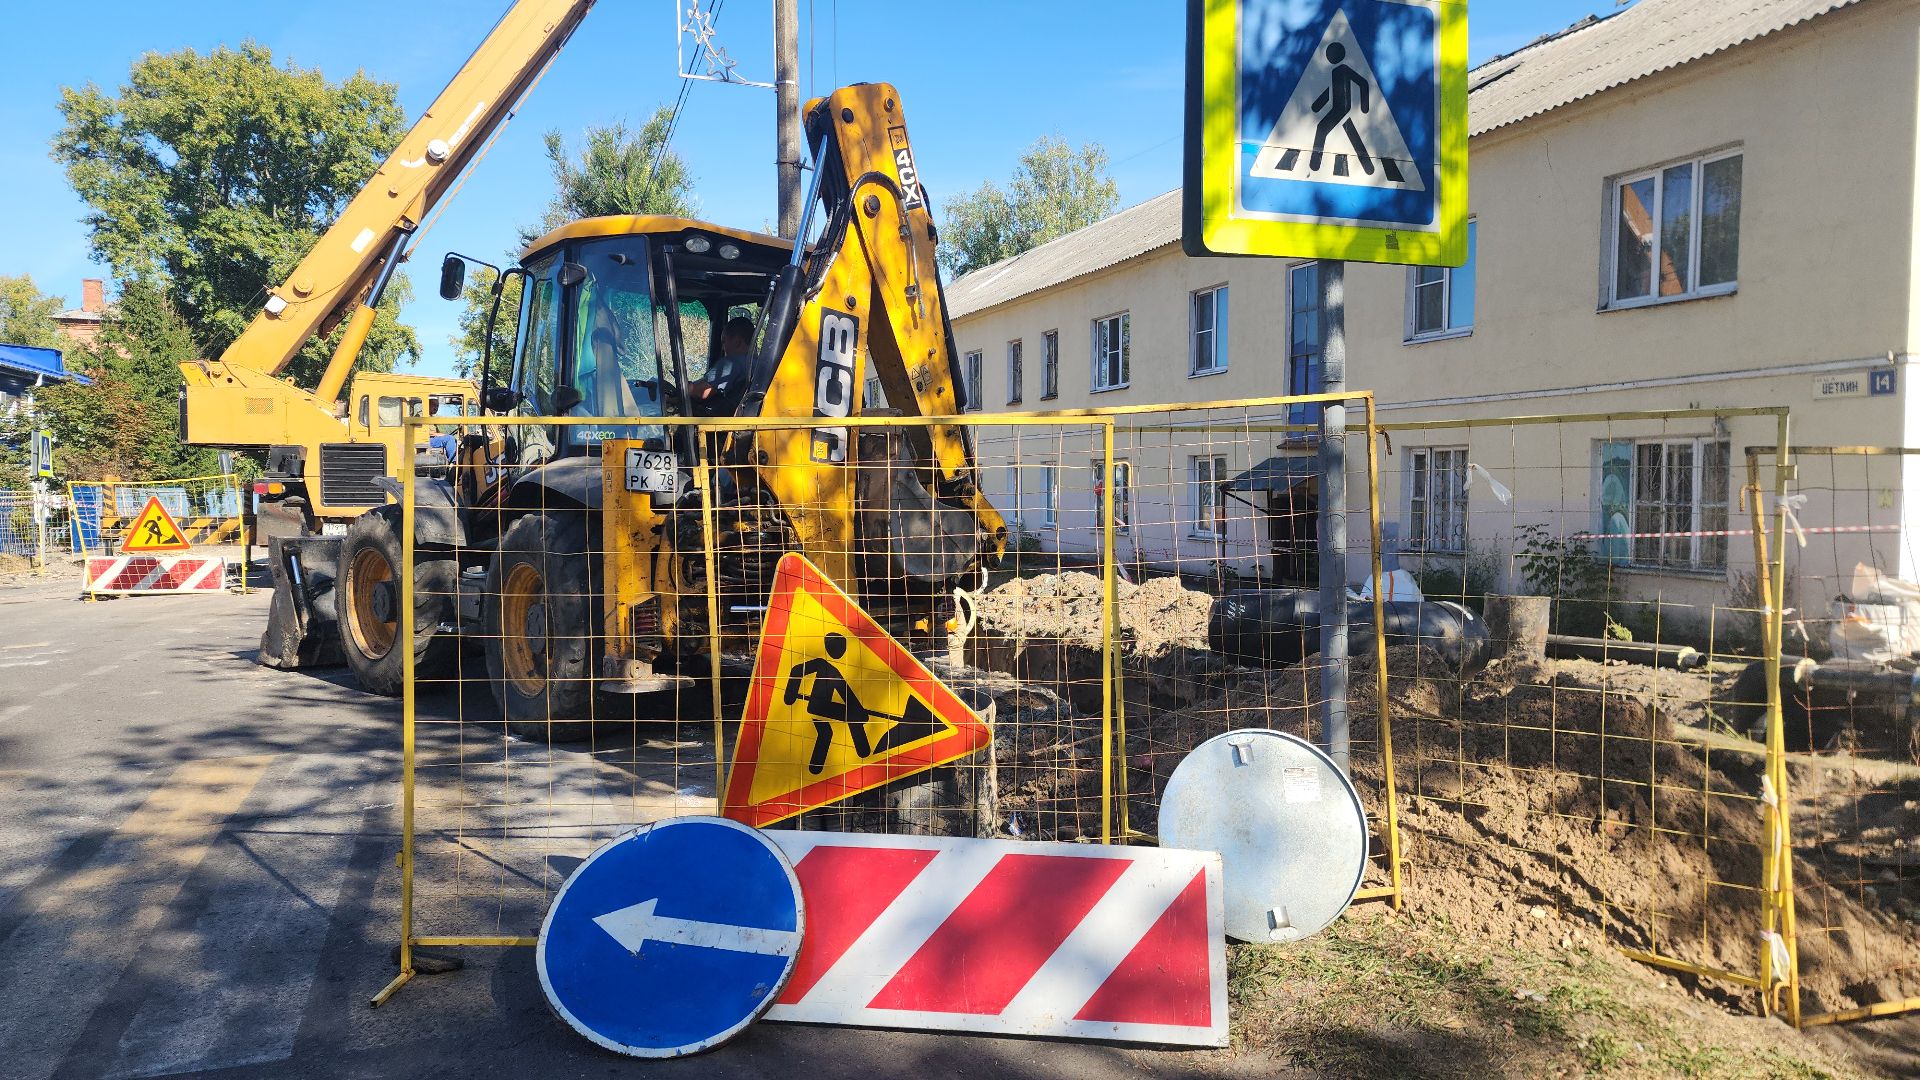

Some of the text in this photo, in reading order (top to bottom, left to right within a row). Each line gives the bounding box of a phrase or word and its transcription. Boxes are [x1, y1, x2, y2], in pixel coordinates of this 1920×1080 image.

[896, 149, 921, 203] 4CX
[1876, 374, 1890, 391] 14
[633, 452, 672, 471] 7628
[660, 473, 674, 486] 78
